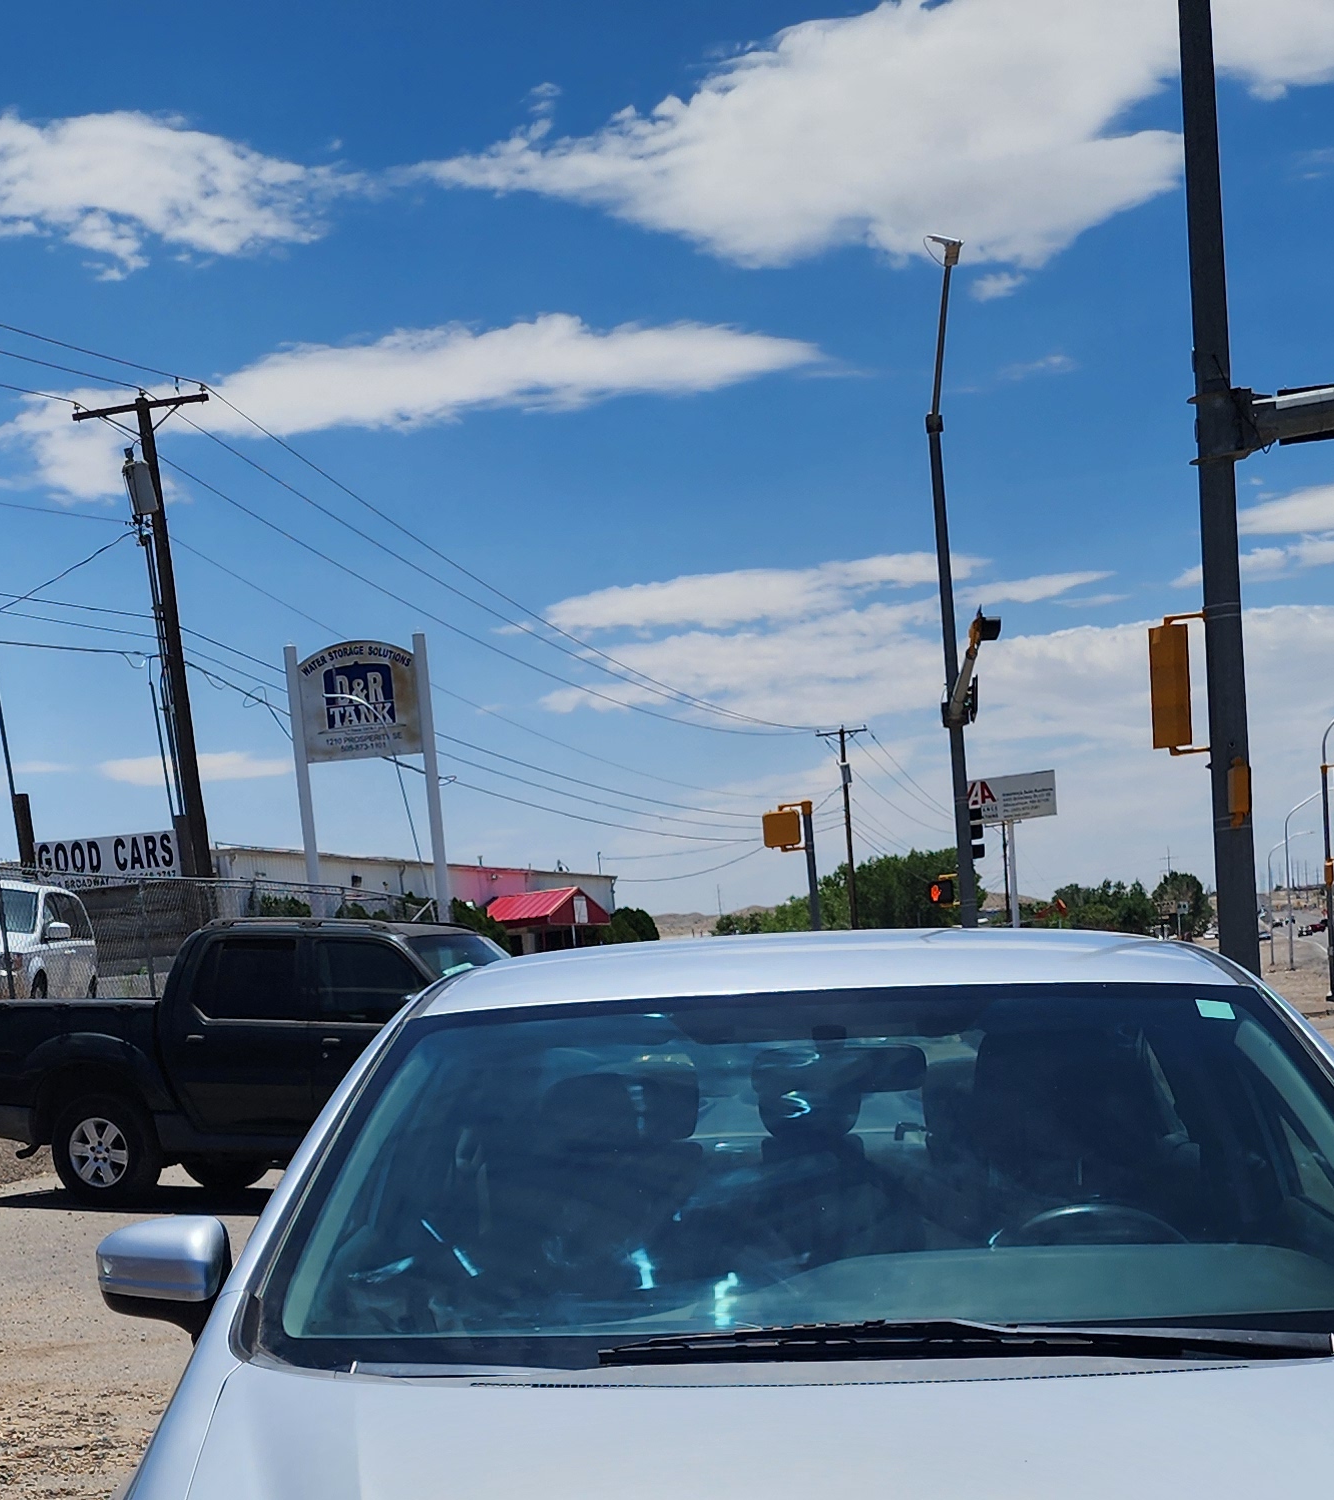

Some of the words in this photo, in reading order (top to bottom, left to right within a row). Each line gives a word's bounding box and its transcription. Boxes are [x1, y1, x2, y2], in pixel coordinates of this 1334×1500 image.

[301, 656, 327, 677] WATER
[328, 645, 364, 662] STORAGE
[367, 645, 412, 667] SOLUTIONS
[335, 671, 385, 706] D&R
[329, 702, 394, 729] TANK
[392, 731, 402, 740] SE
[38, 841, 102, 877] GOOD
[113, 833, 174, 871] CARS
